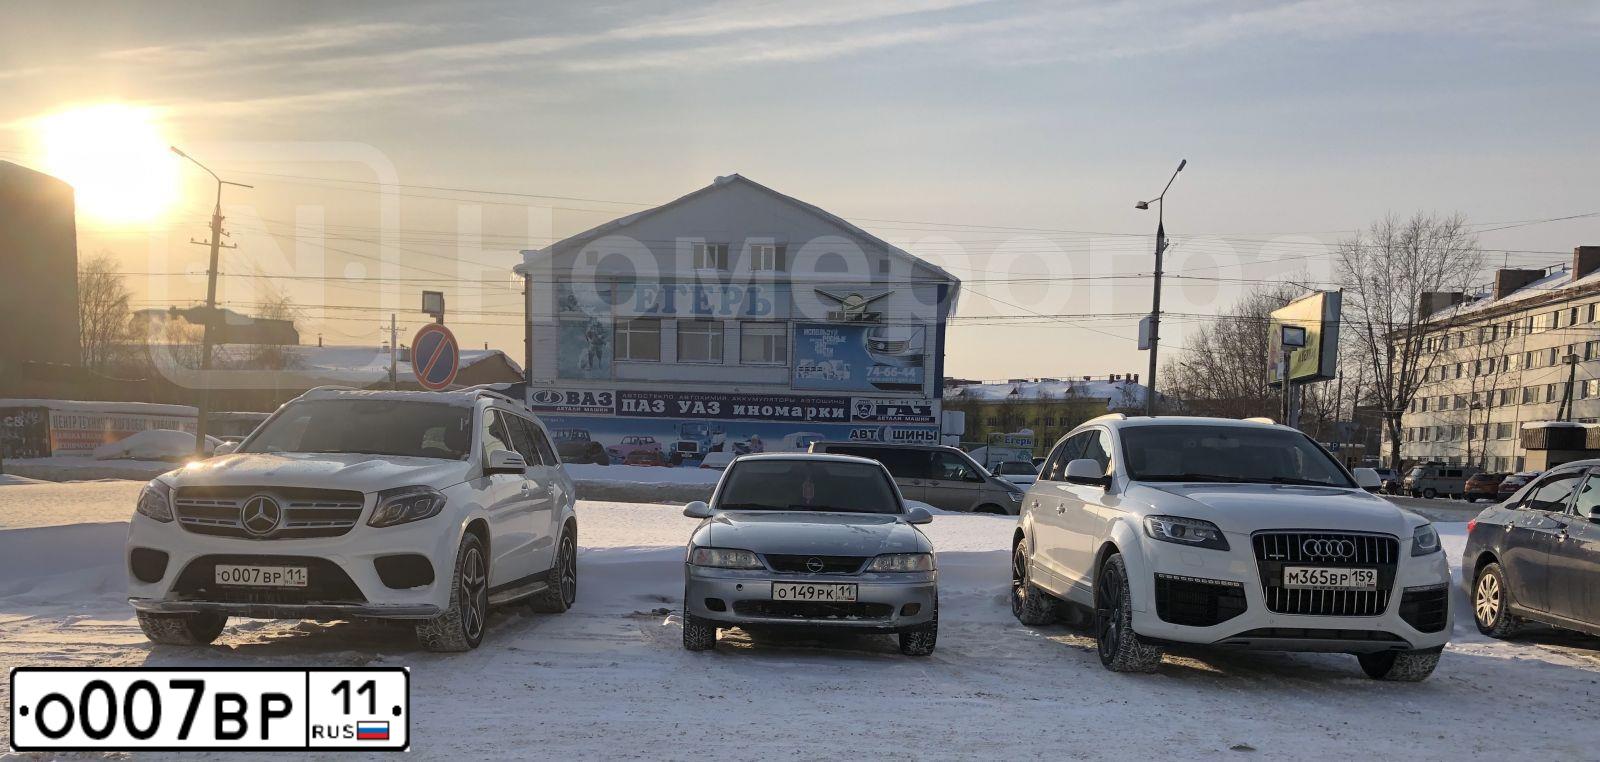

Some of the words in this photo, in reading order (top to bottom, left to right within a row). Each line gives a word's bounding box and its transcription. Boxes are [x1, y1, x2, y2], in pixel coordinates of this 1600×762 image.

[633, 284, 772, 316] ЕГЕРЬ
[866, 366, 915, 377] 74-66-44
[566, 391, 613, 407] ВАЗ
[622, 399, 665, 413] ПАЗ
[678, 400, 721, 415] УАЗ
[733, 403, 845, 420] иномарки
[53, 415, 77, 429] ЦЕНТР
[1005, 435, 1032, 445] Егерь
[287, 569, 301, 580] 11
[1352, 570, 1373, 583] 159
[839, 586, 851, 596] 11
